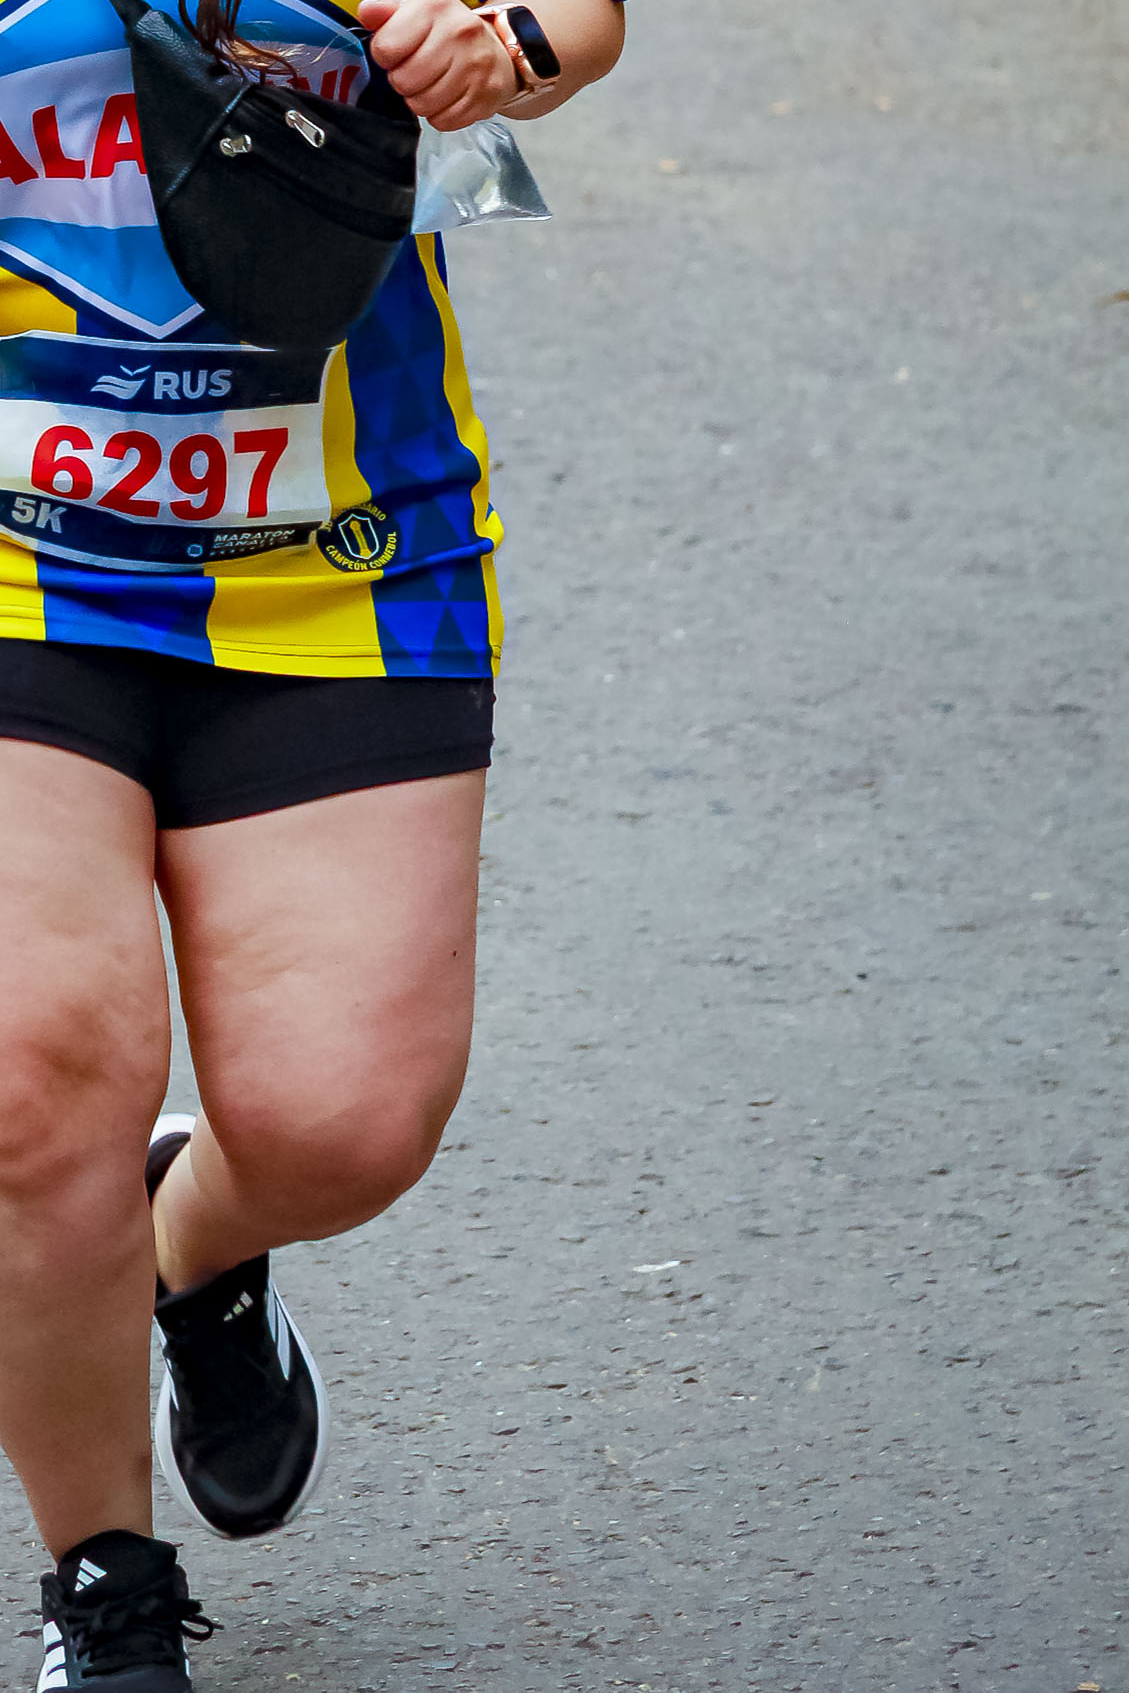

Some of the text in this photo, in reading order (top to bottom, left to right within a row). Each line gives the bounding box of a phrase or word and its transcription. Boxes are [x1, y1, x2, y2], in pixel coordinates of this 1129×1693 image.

[153, 369, 233, 401] RUS
[30, 424, 289, 521] 6297
[10, 495, 68, 534] 5K
